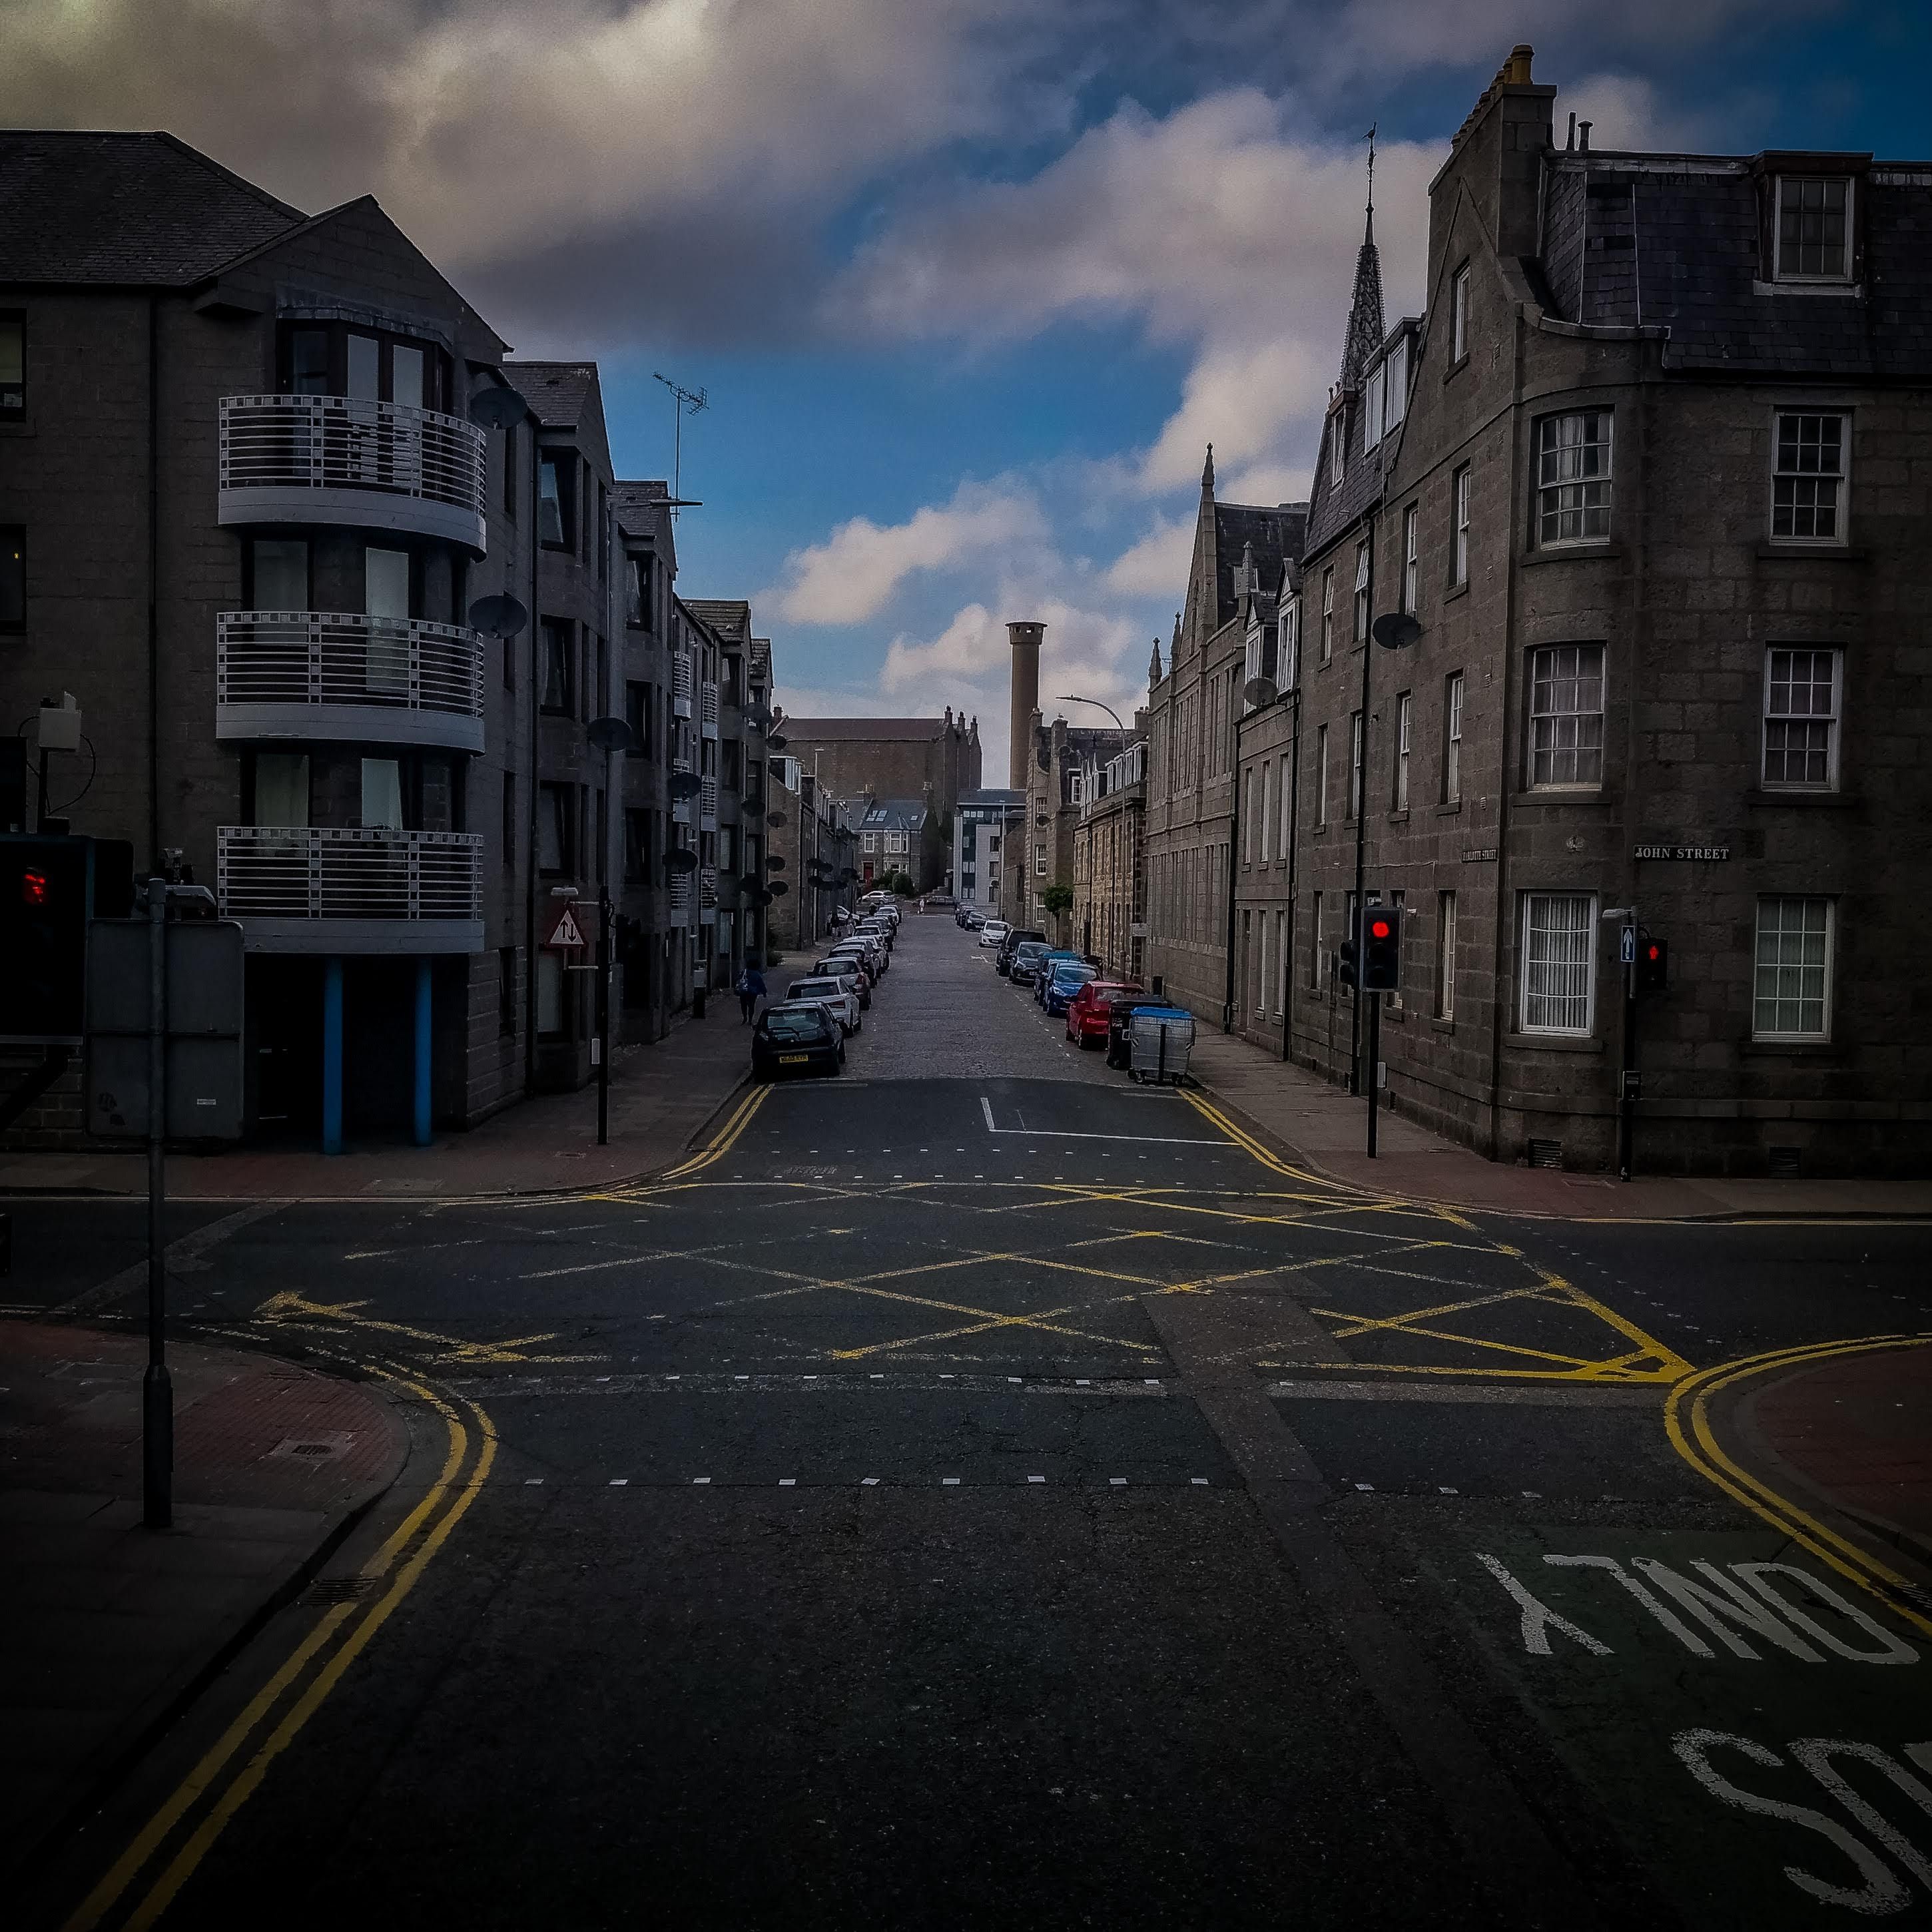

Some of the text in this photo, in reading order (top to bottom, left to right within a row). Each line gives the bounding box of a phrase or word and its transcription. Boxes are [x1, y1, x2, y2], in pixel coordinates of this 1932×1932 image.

[1635, 846, 1730, 860] JOHN STREET
[1474, 1552, 1921, 1664] ONLY
[1668, 1728, 1932, 1918] US
